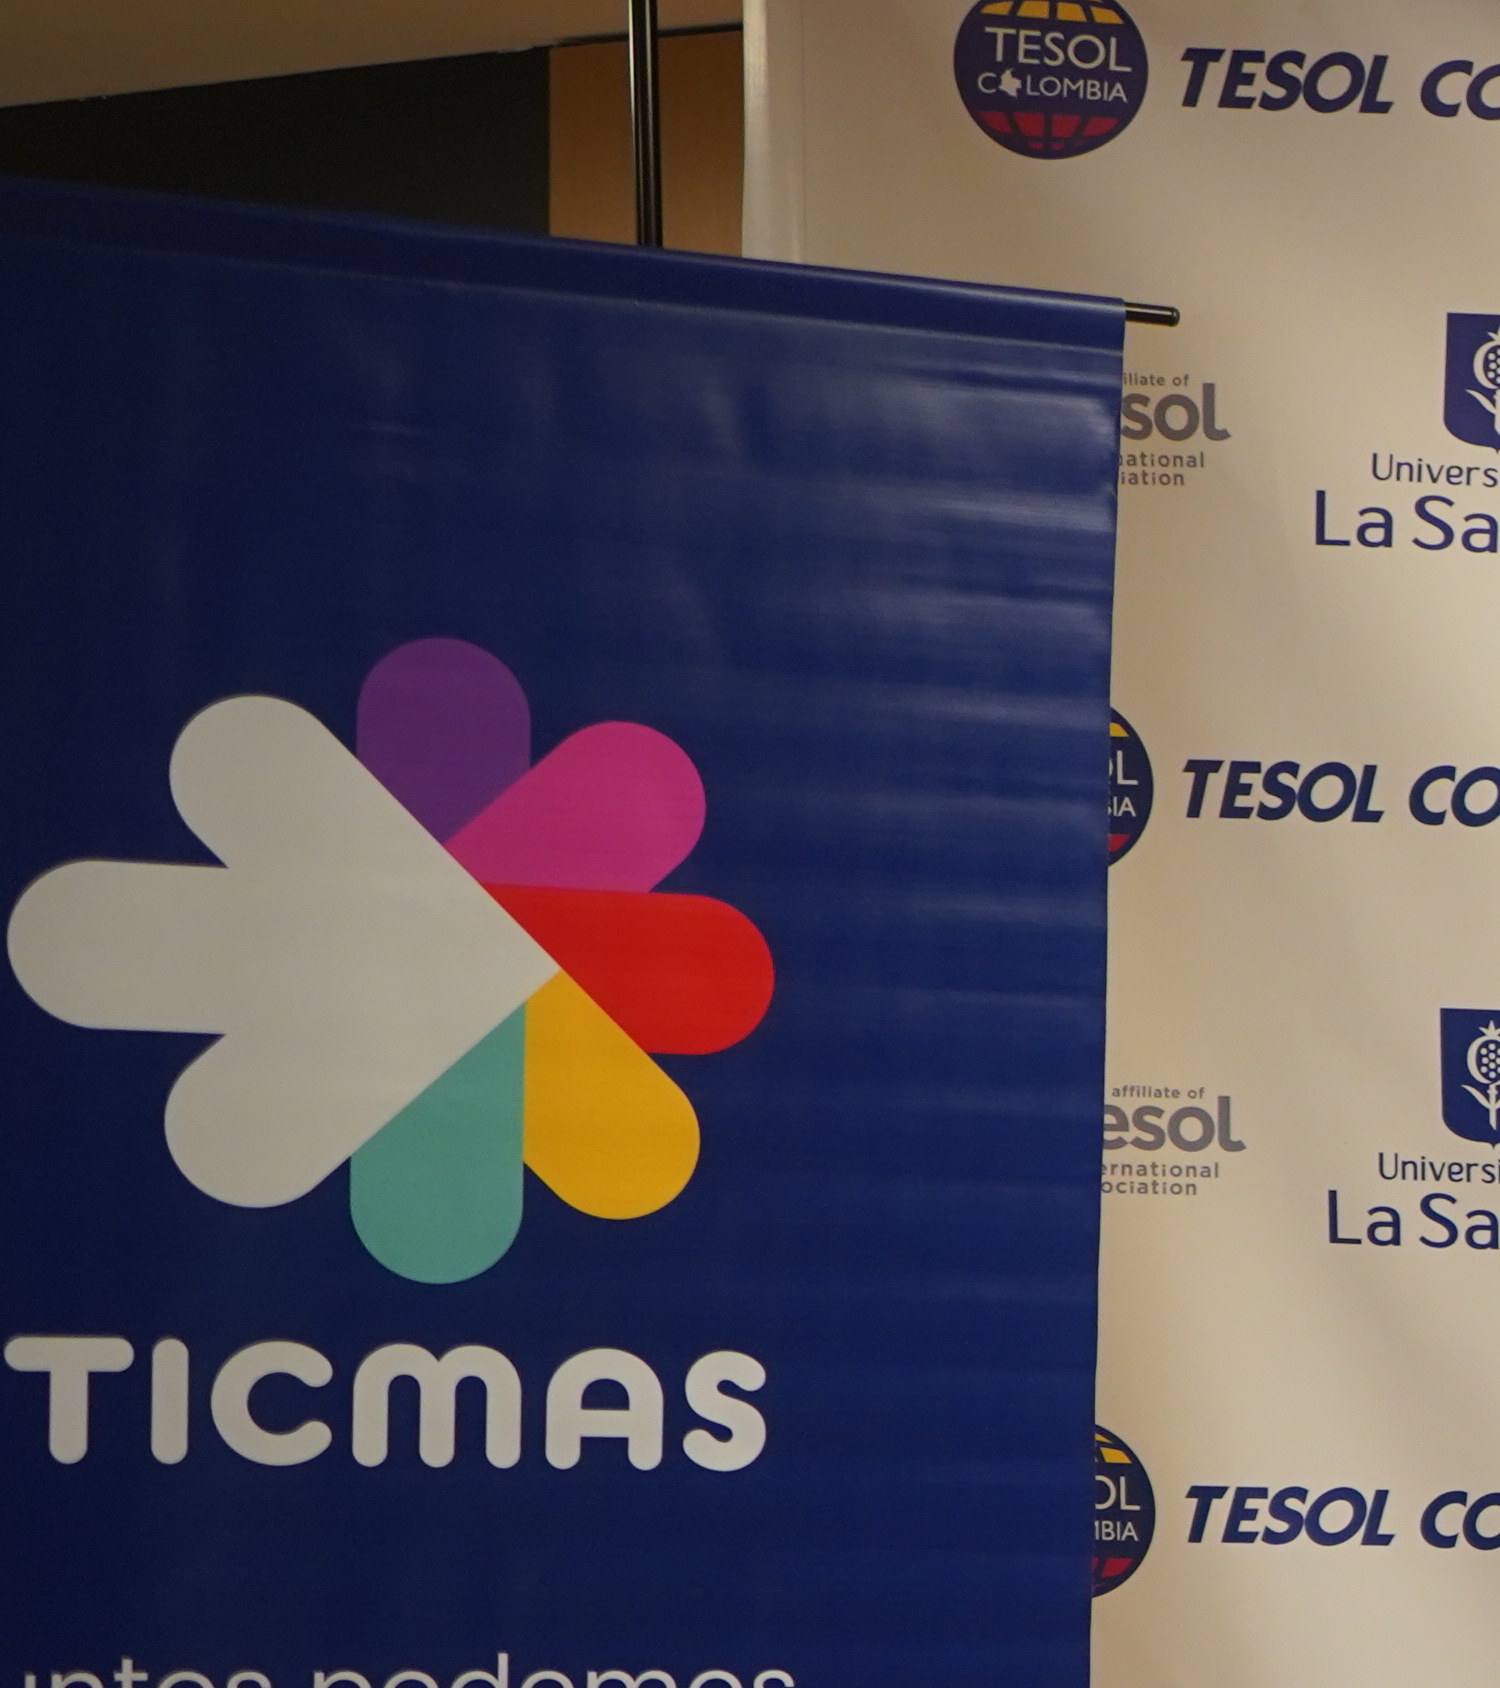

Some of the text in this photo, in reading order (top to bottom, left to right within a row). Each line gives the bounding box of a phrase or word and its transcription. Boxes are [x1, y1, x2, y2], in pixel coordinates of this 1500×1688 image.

[985, 27, 1133, 74] TESOL
[1180, 47, 1395, 115] TESOL
[1123, 372, 1189, 386] iliate of
[1122, 382, 1231, 441] sol
[1120, 452, 1204, 468] ational
[1122, 470, 1184, 486] iation
[1315, 489, 1394, 549] La
[1182, 758, 1385, 824] TESOL
[1111, 1085, 1205, 1099] affiliate of
[1104, 1095, 1246, 1152] esol
[1101, 1162, 1219, 1178] ernational
[1101, 1179, 1197, 1195] ociation
[1327, 1189, 1402, 1247] La
[3, 1336, 767, 1472] TICMAS
[1184, 1484, 1396, 1547] TESOL
